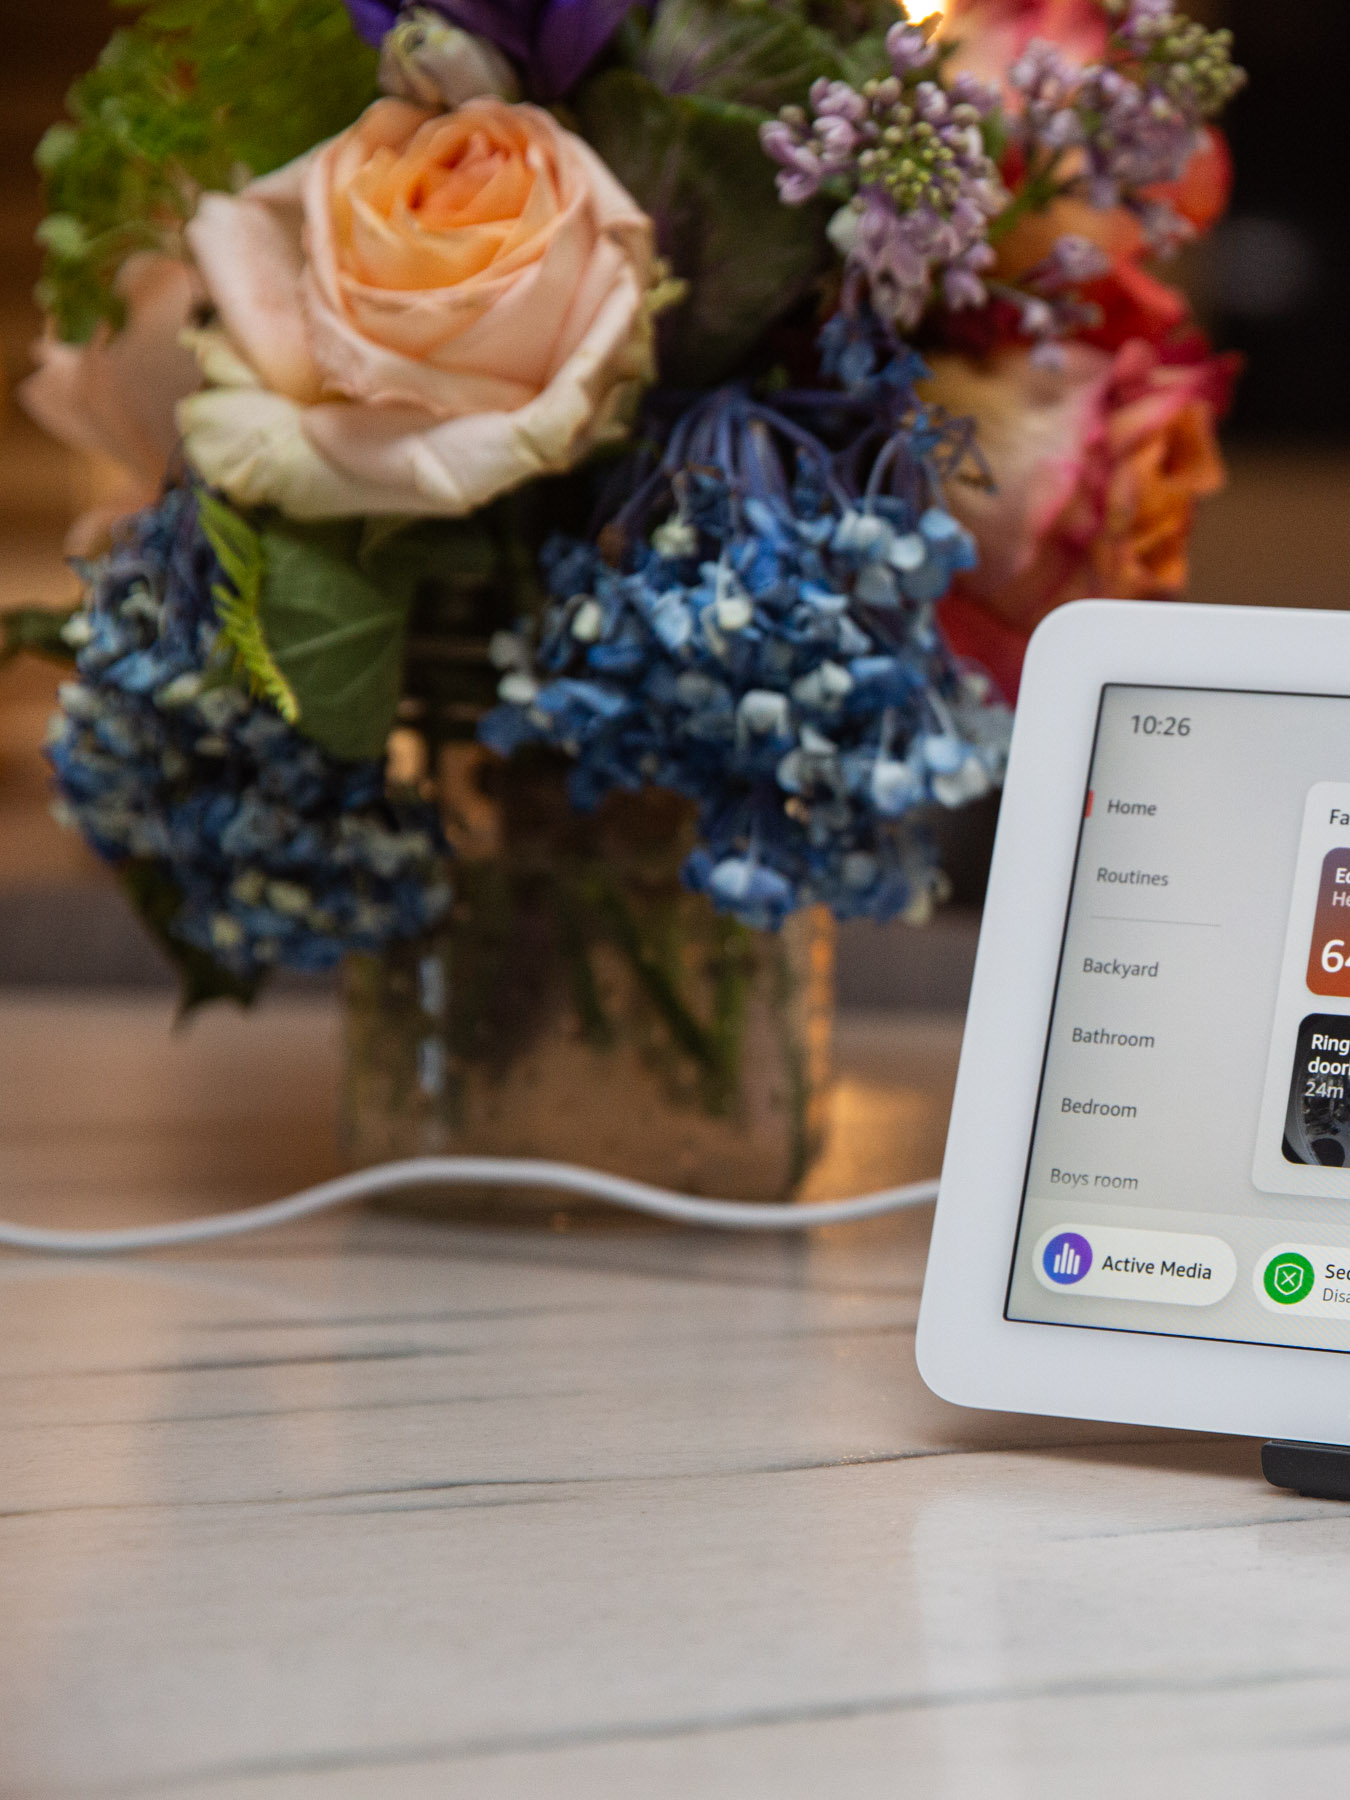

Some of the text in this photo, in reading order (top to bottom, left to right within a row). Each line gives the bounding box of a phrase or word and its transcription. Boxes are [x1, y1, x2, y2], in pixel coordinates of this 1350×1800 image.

[1130, 714, 1192, 737] 10:26
[1106, 798, 1158, 817] Home
[1096, 866, 1170, 888] Routines
[1082, 957, 1159, 980] Backyard
[1071, 1027, 1156, 1049] Bathroom
[1303, 1081, 1345, 1100] 24m
[1060, 1097, 1138, 1119] Bedroom
[1049, 1167, 1139, 1191] Boys room
[1101, 1254, 1213, 1281] Active Media
